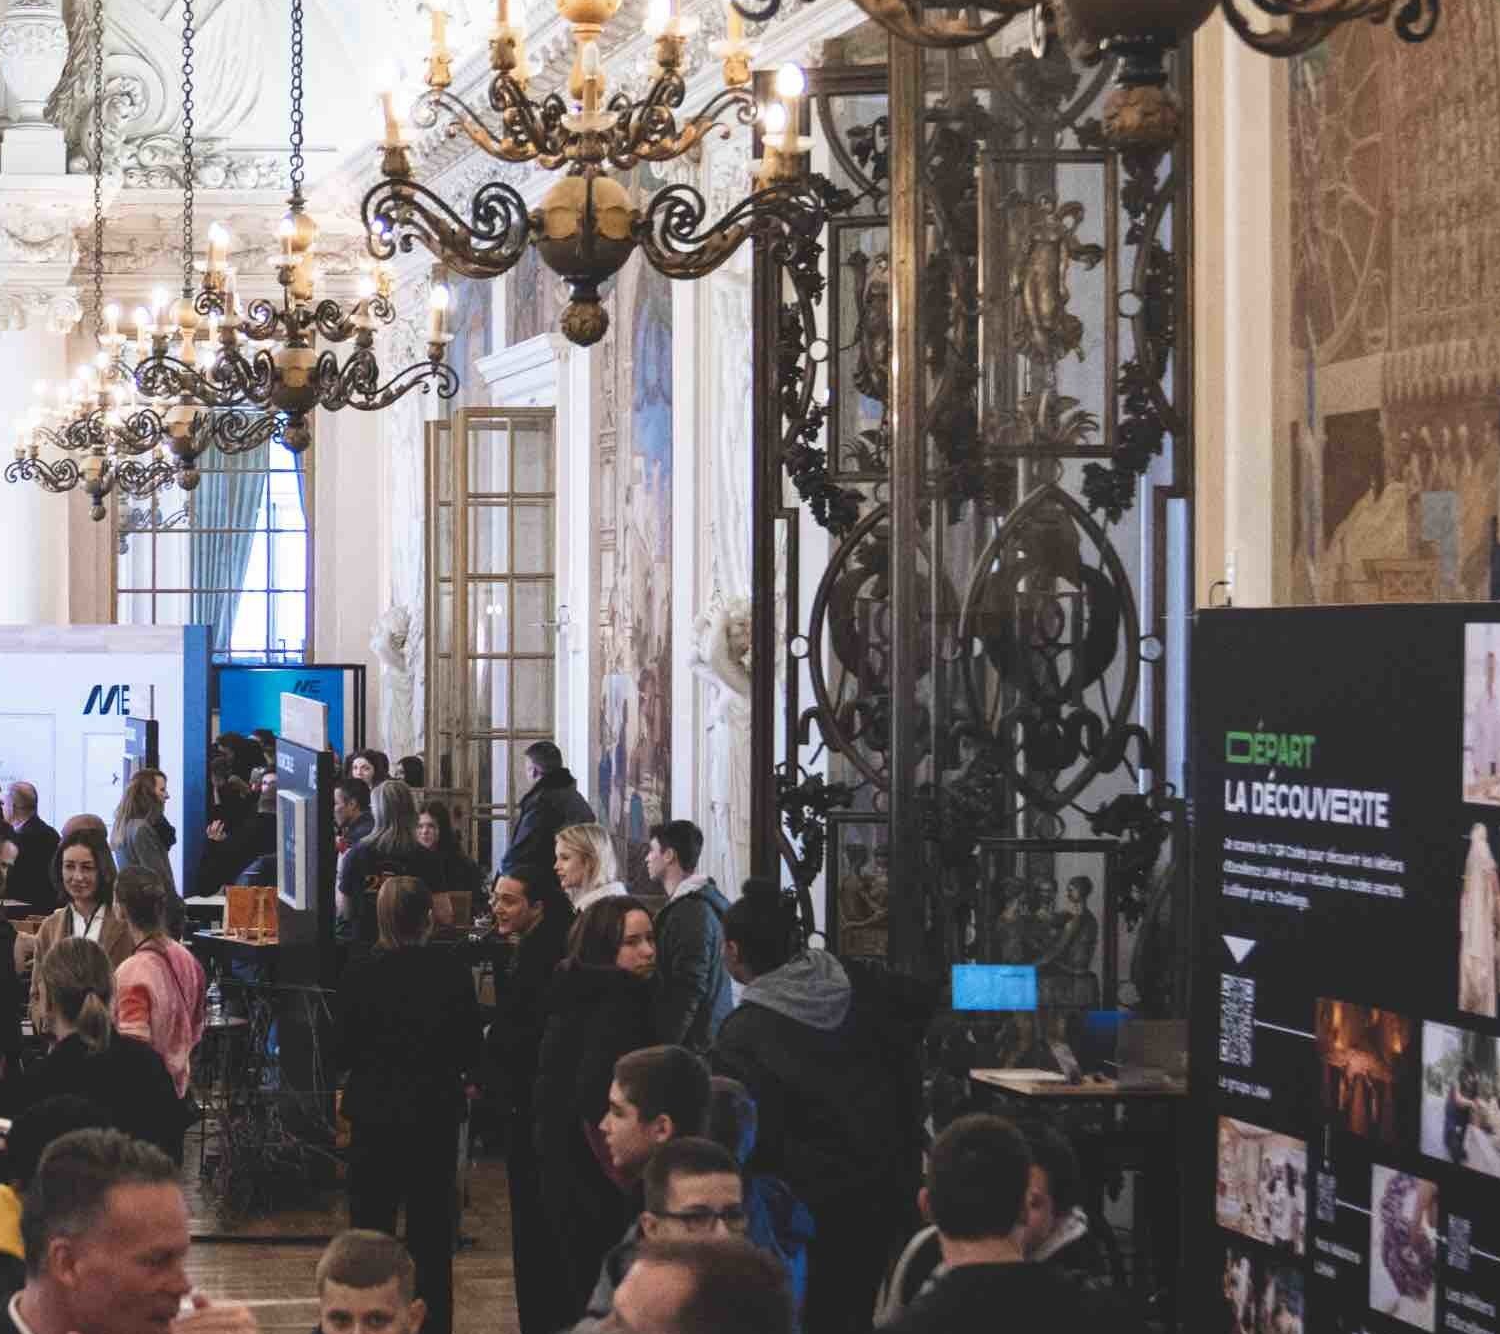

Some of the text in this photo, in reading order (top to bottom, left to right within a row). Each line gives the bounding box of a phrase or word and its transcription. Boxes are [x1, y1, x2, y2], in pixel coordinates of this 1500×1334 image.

[1224, 717, 1316, 768] DÉPART
[1224, 769, 1390, 828] LA DÉCOUVERTE
